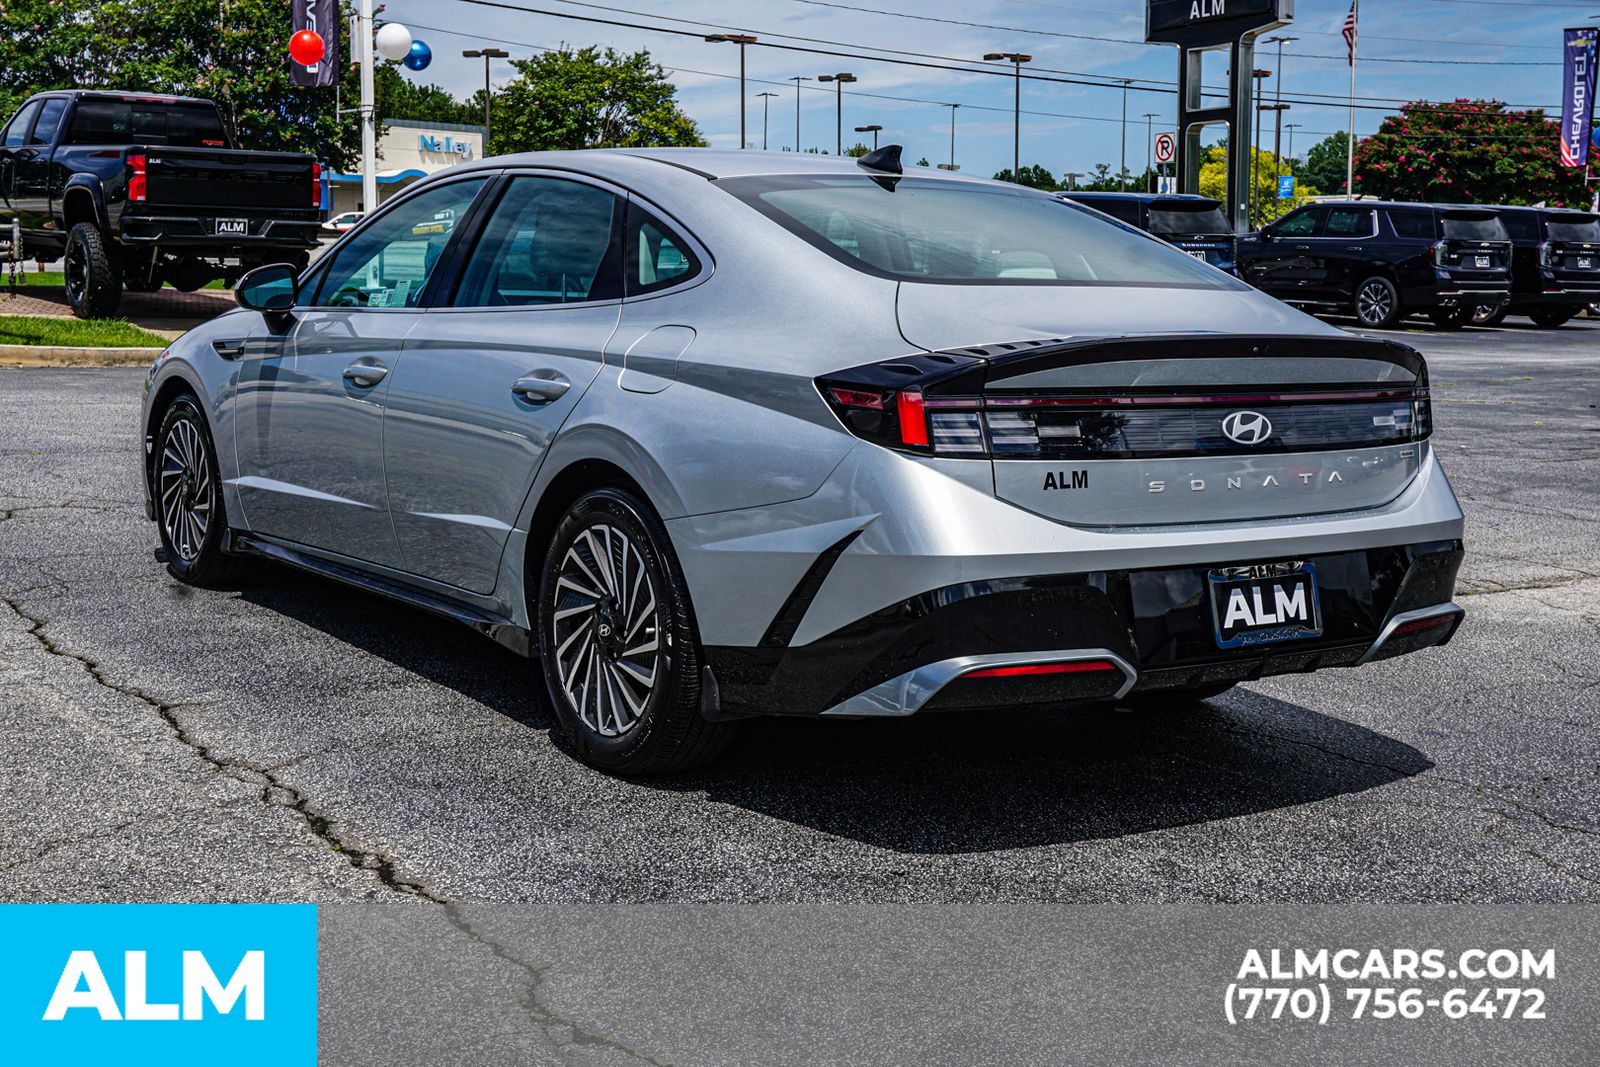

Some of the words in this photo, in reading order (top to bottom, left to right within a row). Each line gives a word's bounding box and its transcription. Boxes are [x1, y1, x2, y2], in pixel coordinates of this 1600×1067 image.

[1189, 0, 1225, 19] ALM
[418, 134, 473, 159] Nalley
[219, 222, 244, 232] ALM
[1043, 470, 1089, 491] ALM
[1149, 471, 1344, 493] SONATA
[1223, 582, 1308, 629] ALM
